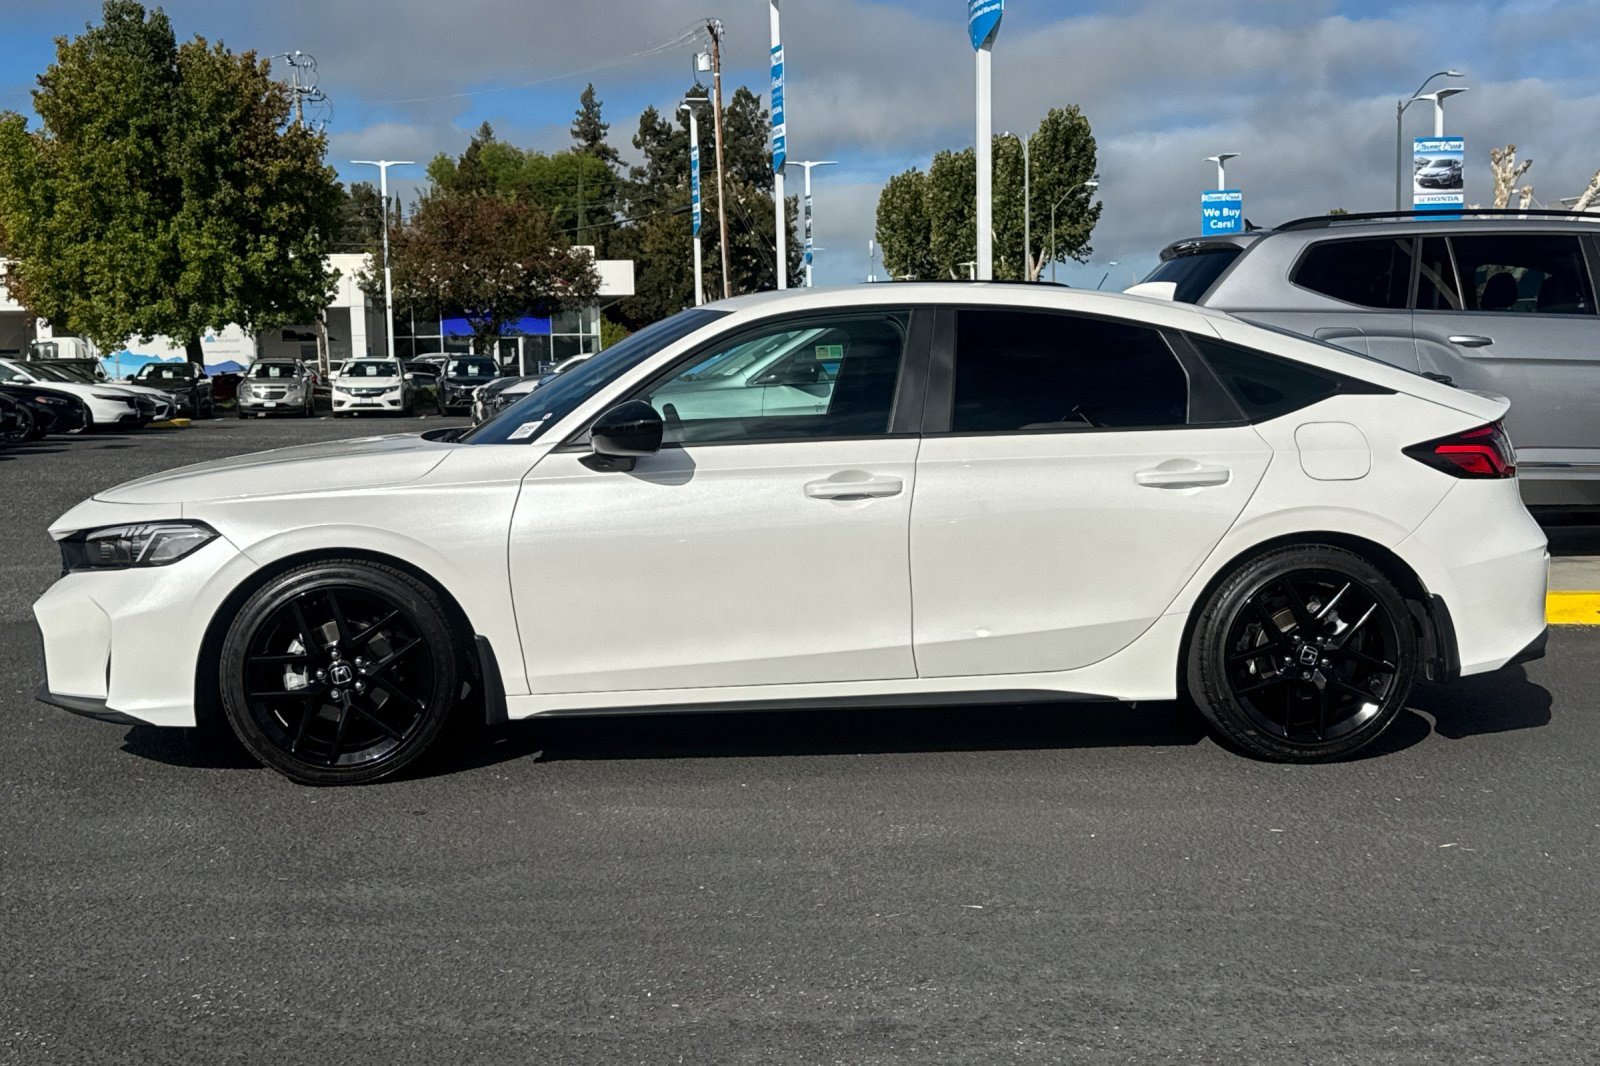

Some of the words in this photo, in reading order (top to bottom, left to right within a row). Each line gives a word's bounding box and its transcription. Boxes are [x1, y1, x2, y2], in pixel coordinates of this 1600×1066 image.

[1203, 207, 1221, 217] We
[1222, 207, 1240, 219] Buy
[1209, 218, 1235, 229] Cars!
